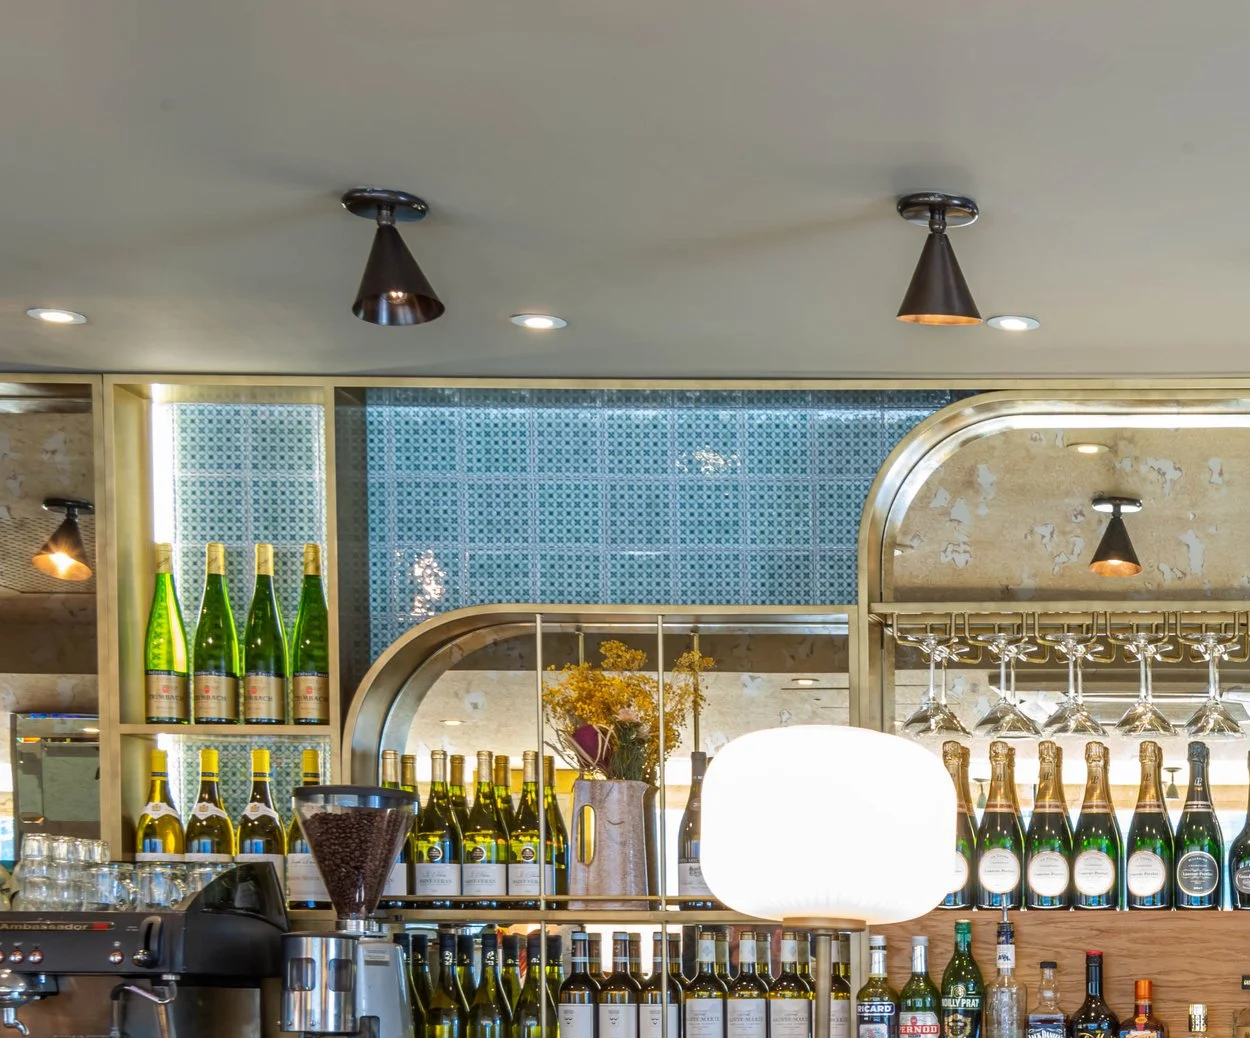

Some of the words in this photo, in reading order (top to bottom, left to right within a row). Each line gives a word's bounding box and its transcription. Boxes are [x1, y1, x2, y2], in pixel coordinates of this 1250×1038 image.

[0, 923, 88, 931] Ambassador
[961, 998, 980, 1008] PRAT
[857, 1004, 892, 1013] RICARD
